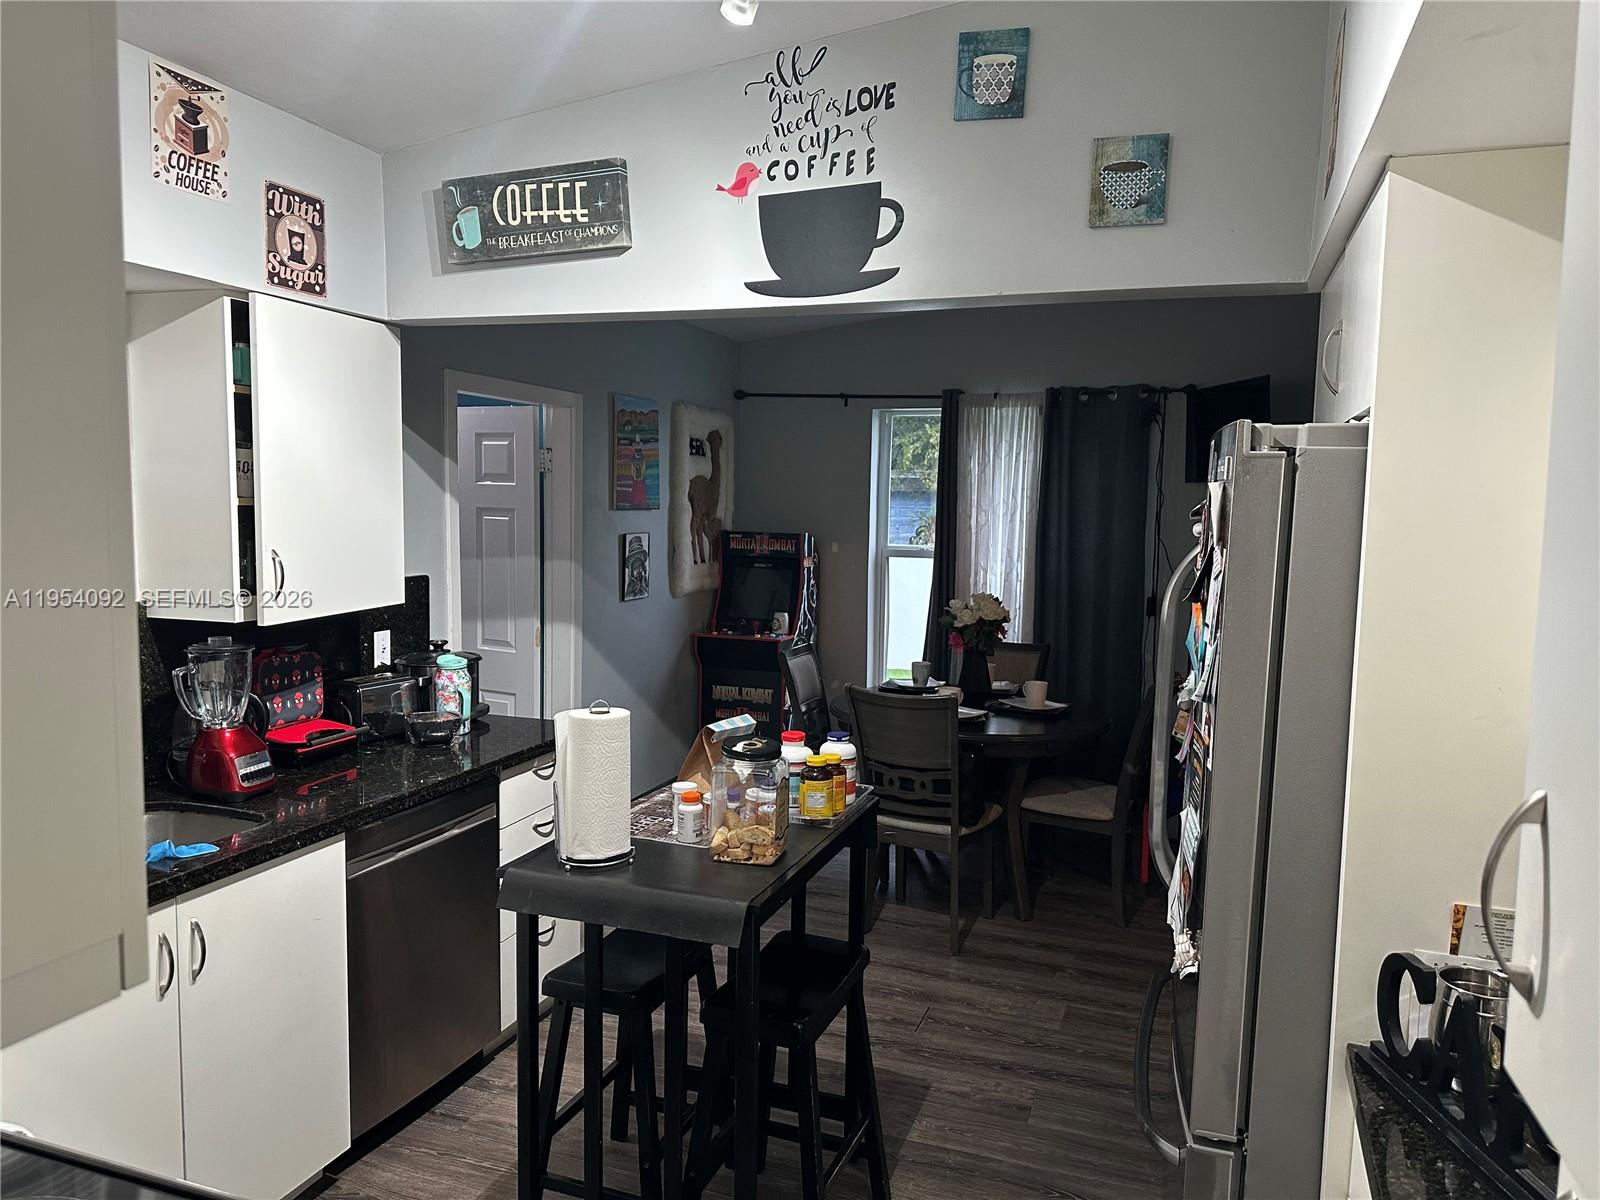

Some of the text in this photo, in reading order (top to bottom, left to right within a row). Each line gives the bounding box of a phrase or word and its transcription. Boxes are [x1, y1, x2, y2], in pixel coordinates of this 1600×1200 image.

[744, 45, 828, 96] all
[768, 87, 826, 124] you
[773, 81, 897, 138] need is LOVE
[745, 115, 878, 160] and a cup of
[167, 149, 220, 183] COFFEE
[766, 146, 876, 182] COFFEE
[175, 171, 212, 196] HOUSE
[267, 189, 323, 227] With
[492, 180, 590, 226] COFFEE
[486, 237, 497, 246] THE
[564, 229, 573, 238] OF
[573, 223, 620, 239] CHAMPIONS
[267, 251, 326, 290] Sugar
